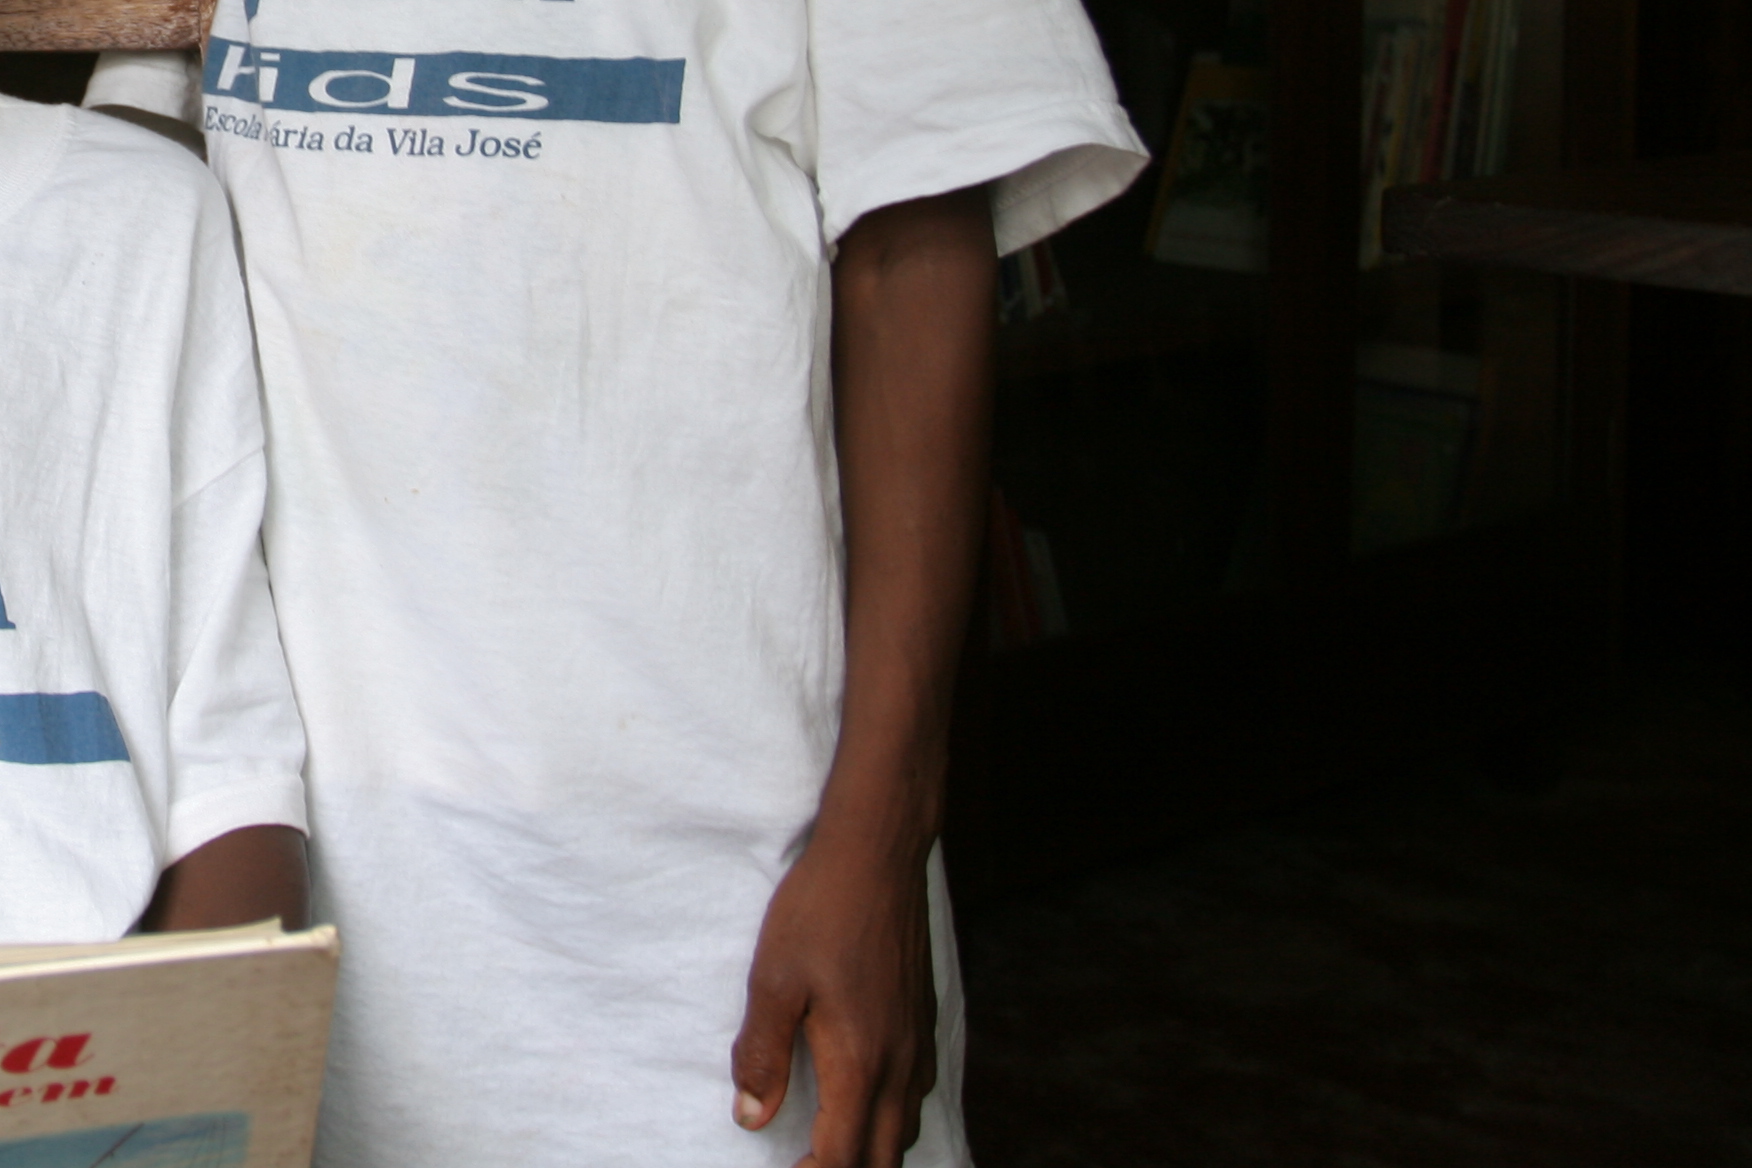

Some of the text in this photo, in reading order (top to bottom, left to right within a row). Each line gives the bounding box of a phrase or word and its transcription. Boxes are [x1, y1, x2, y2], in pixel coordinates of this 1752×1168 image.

[205, 106, 263, 141] Escola
[334, 125, 373, 153] da
[386, 128, 445, 157] Vila
[455, 128, 543, 159] José
